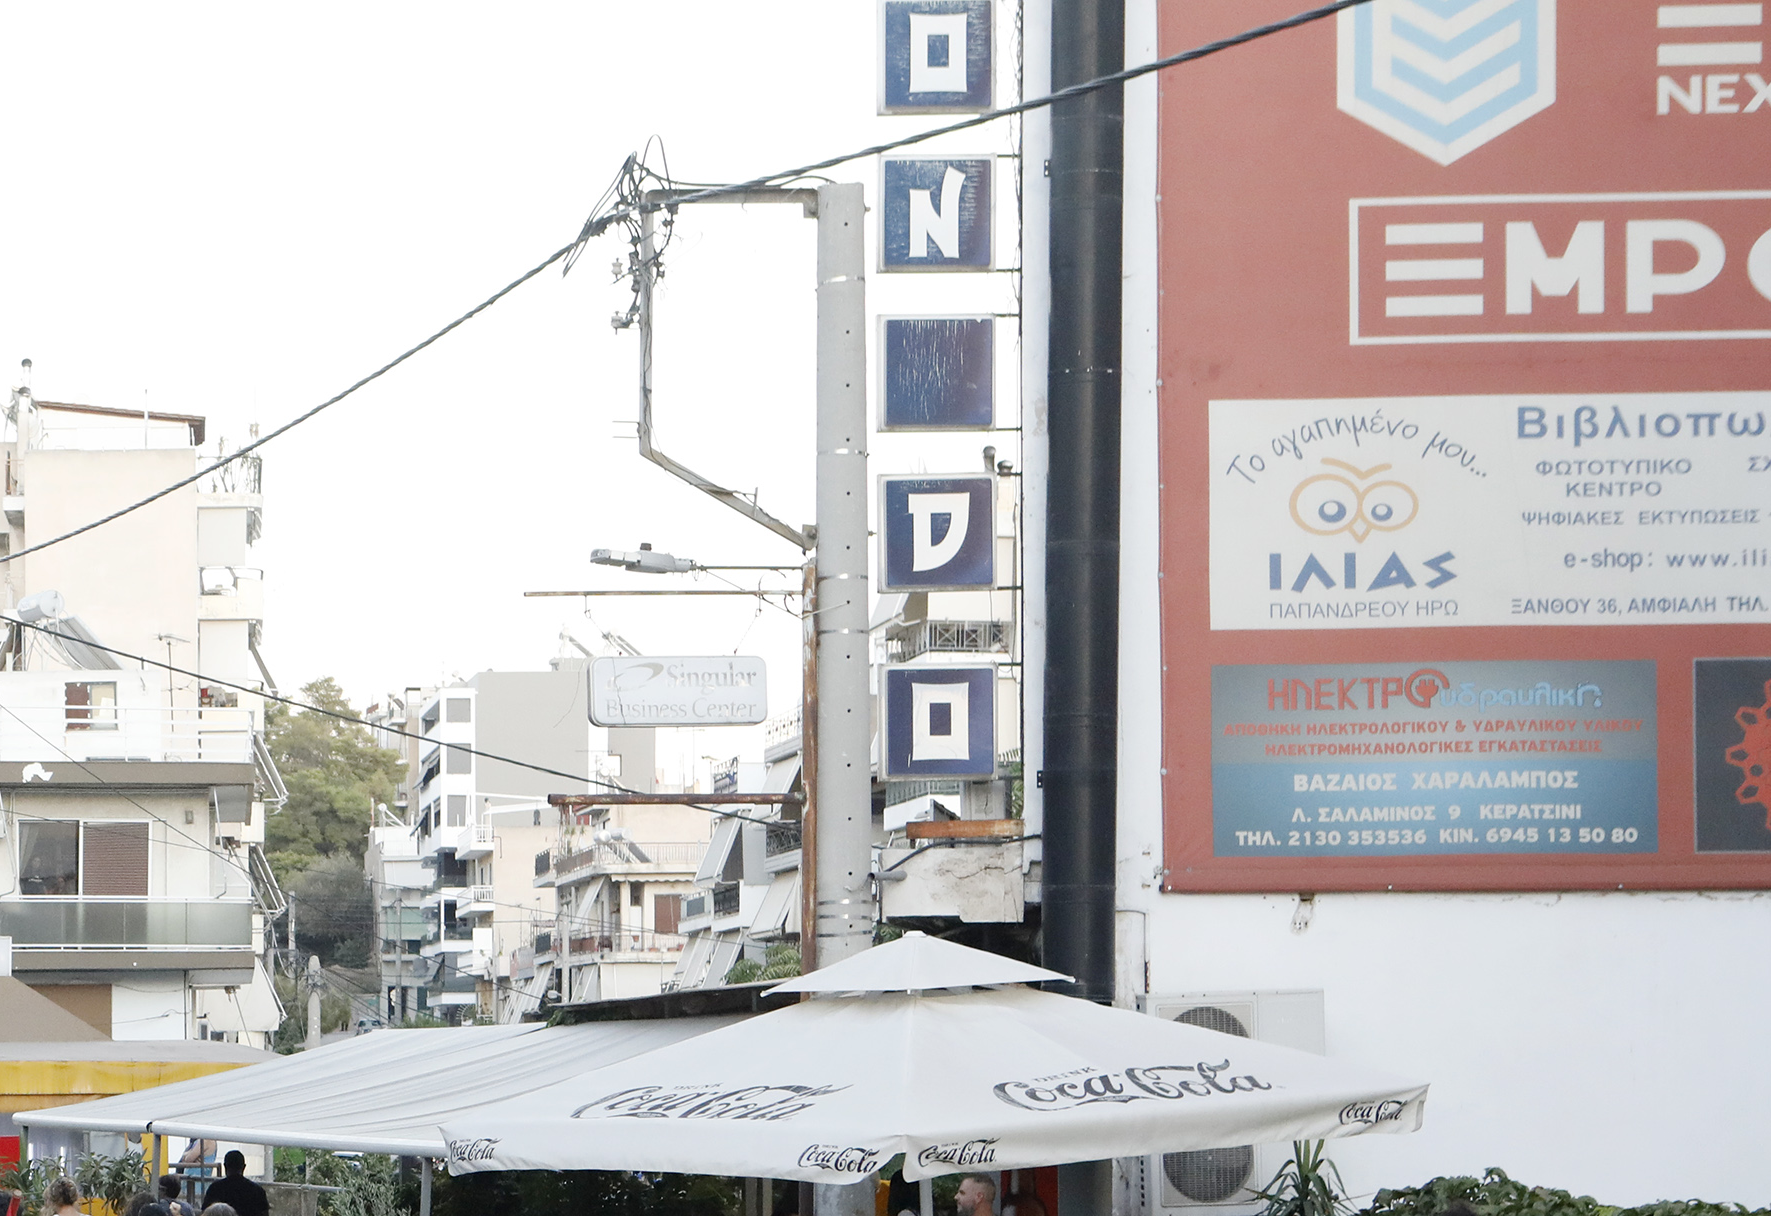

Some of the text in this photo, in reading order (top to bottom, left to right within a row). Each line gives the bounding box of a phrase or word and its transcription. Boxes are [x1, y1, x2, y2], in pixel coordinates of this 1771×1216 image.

[1385, 219, 1771, 318] EMP
[1517, 405, 1771, 448] Βιβλιοπω
[1226, 454, 1266, 484] Το
[1271, 408, 1419, 461] αγαπημένο
[1535, 458, 1693, 477] ΦΩΤΟΤΥΠΙΚΟ
[1565, 481, 1663, 498] ΚΕΝΤΡΟ
[1521, 508, 1761, 526] ΨΗΦΙΑΚΕΣ ΕΚΤΥΠΩΣΕΙΣ
[1269, 551, 1458, 593] ΙΛΙΑΣ
[1269, 599, 1459, 619] ΠΑΠΑΝΔΡΕΟΥ ΗΡΩ
[1511, 596, 1770, 616] ΞΑΝΘΟΥ 36, ΑΜΦΙΑΛΗ ΤΗΛ.
[666, 661, 757, 695] Singular
[606, 697, 757, 718] Business Center
[1223, 718, 1644, 736] ΑΠΟΘΗΚΗ ΗΛΕΚΤΡΟΛΟΓΙΚΟΥ & ΥΔΡΑΥΛΙΚΟΥ ΥΛΙΚΟΥ
[1264, 739, 1603, 756] ΗΛΕΚΤΡΟΜΗΧΑΝΟΛΟΓΙΚΕΣ ΕΓΚΑΤΑΣΤΑΣΕΙΣ
[1293, 770, 1579, 792] ΒΑΖΑΙΟΣ ΧΑΡΑΛΑΜΠΟΣ
[1291, 804, 1582, 823] Λ. ΣΑΛΑΜΙΝΟΣ 9 ΚΕΡΑΤΣΙΝΙ
[1235, 827, 1639, 846] ΤΗΛ. 2130 353536 ΚΙΝ. 6945 13 50 80
[1032, 1065, 1097, 1084] DRINK
